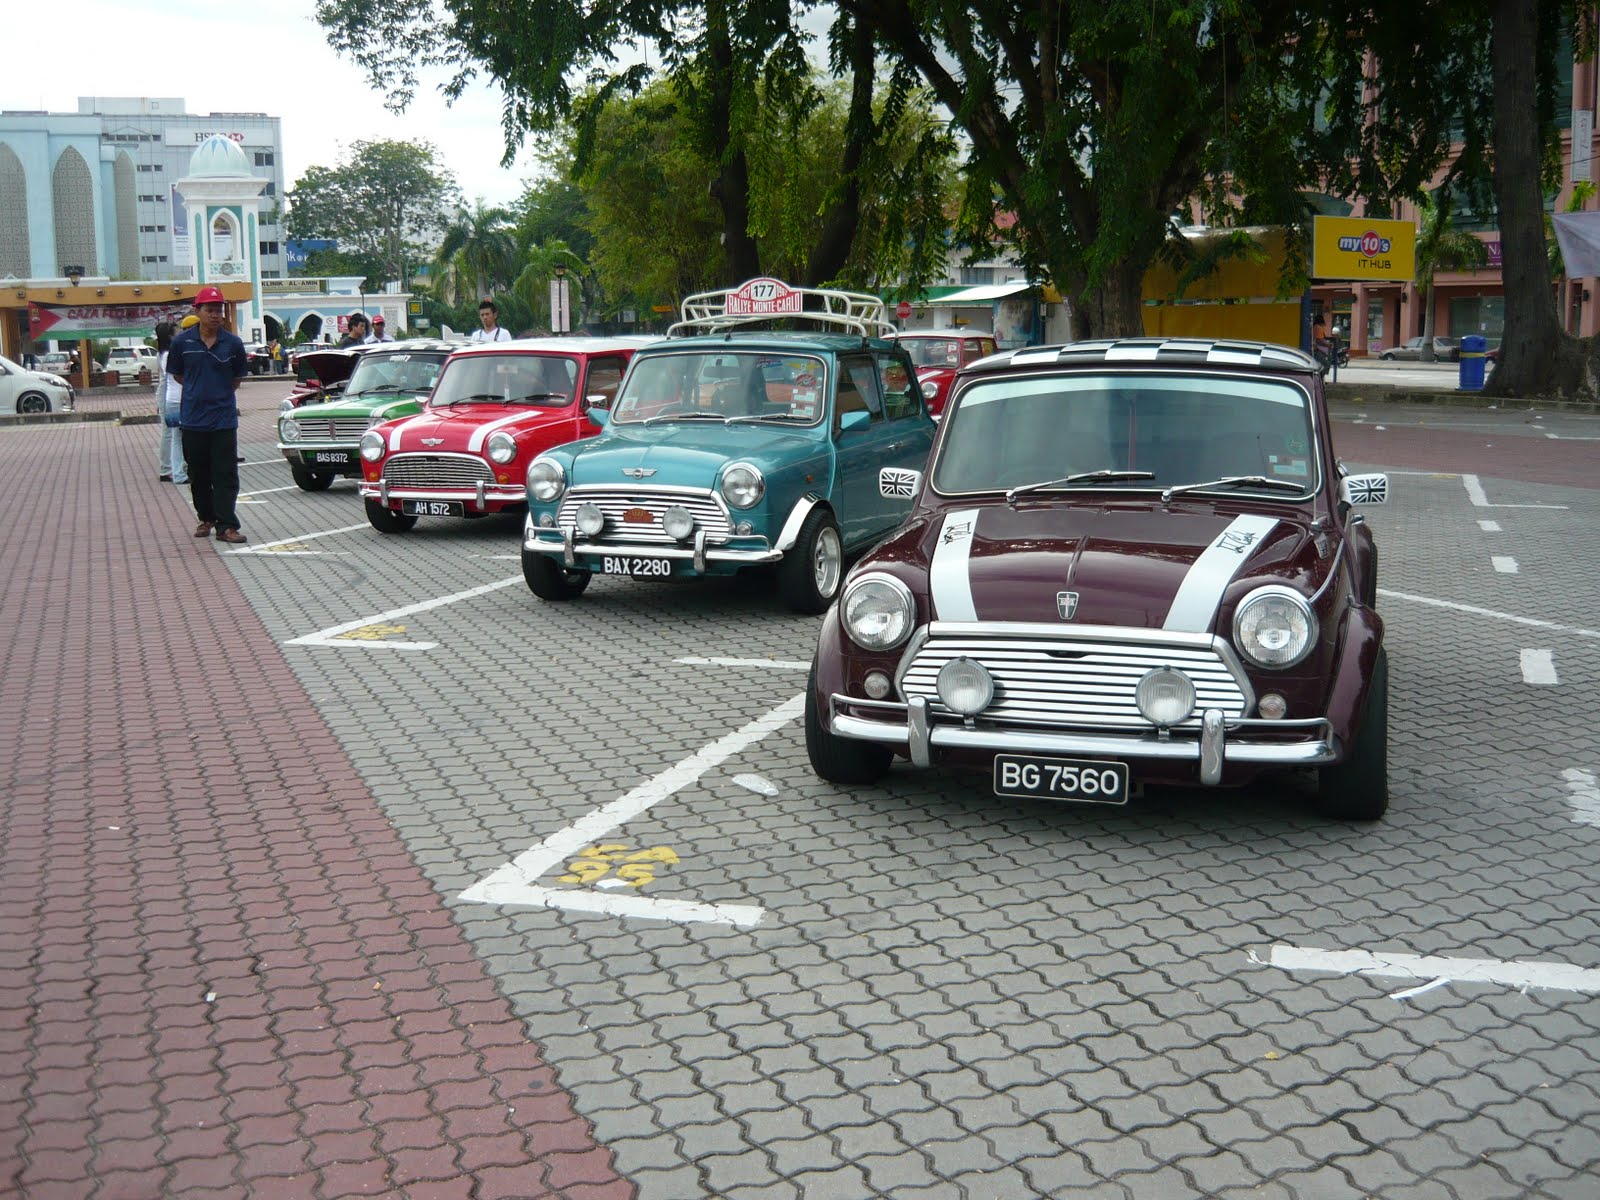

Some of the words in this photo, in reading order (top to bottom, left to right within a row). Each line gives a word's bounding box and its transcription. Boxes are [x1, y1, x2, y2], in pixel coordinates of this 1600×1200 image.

[195, 132, 227, 142] HS
[1370, 260, 1392, 269] HUB
[753, 284, 775, 298] 177
[728, 294, 751, 313] RALLYE
[316, 452, 331, 463] BAS
[330, 452, 349, 463] 8372
[415, 502, 428, 515] AH
[430, 502, 451, 515] 1572
[603, 556, 632, 575] BAX
[632, 558, 671, 576] 2280
[1002, 761, 1041, 789] BG
[1043, 764, 1120, 796] 7560
